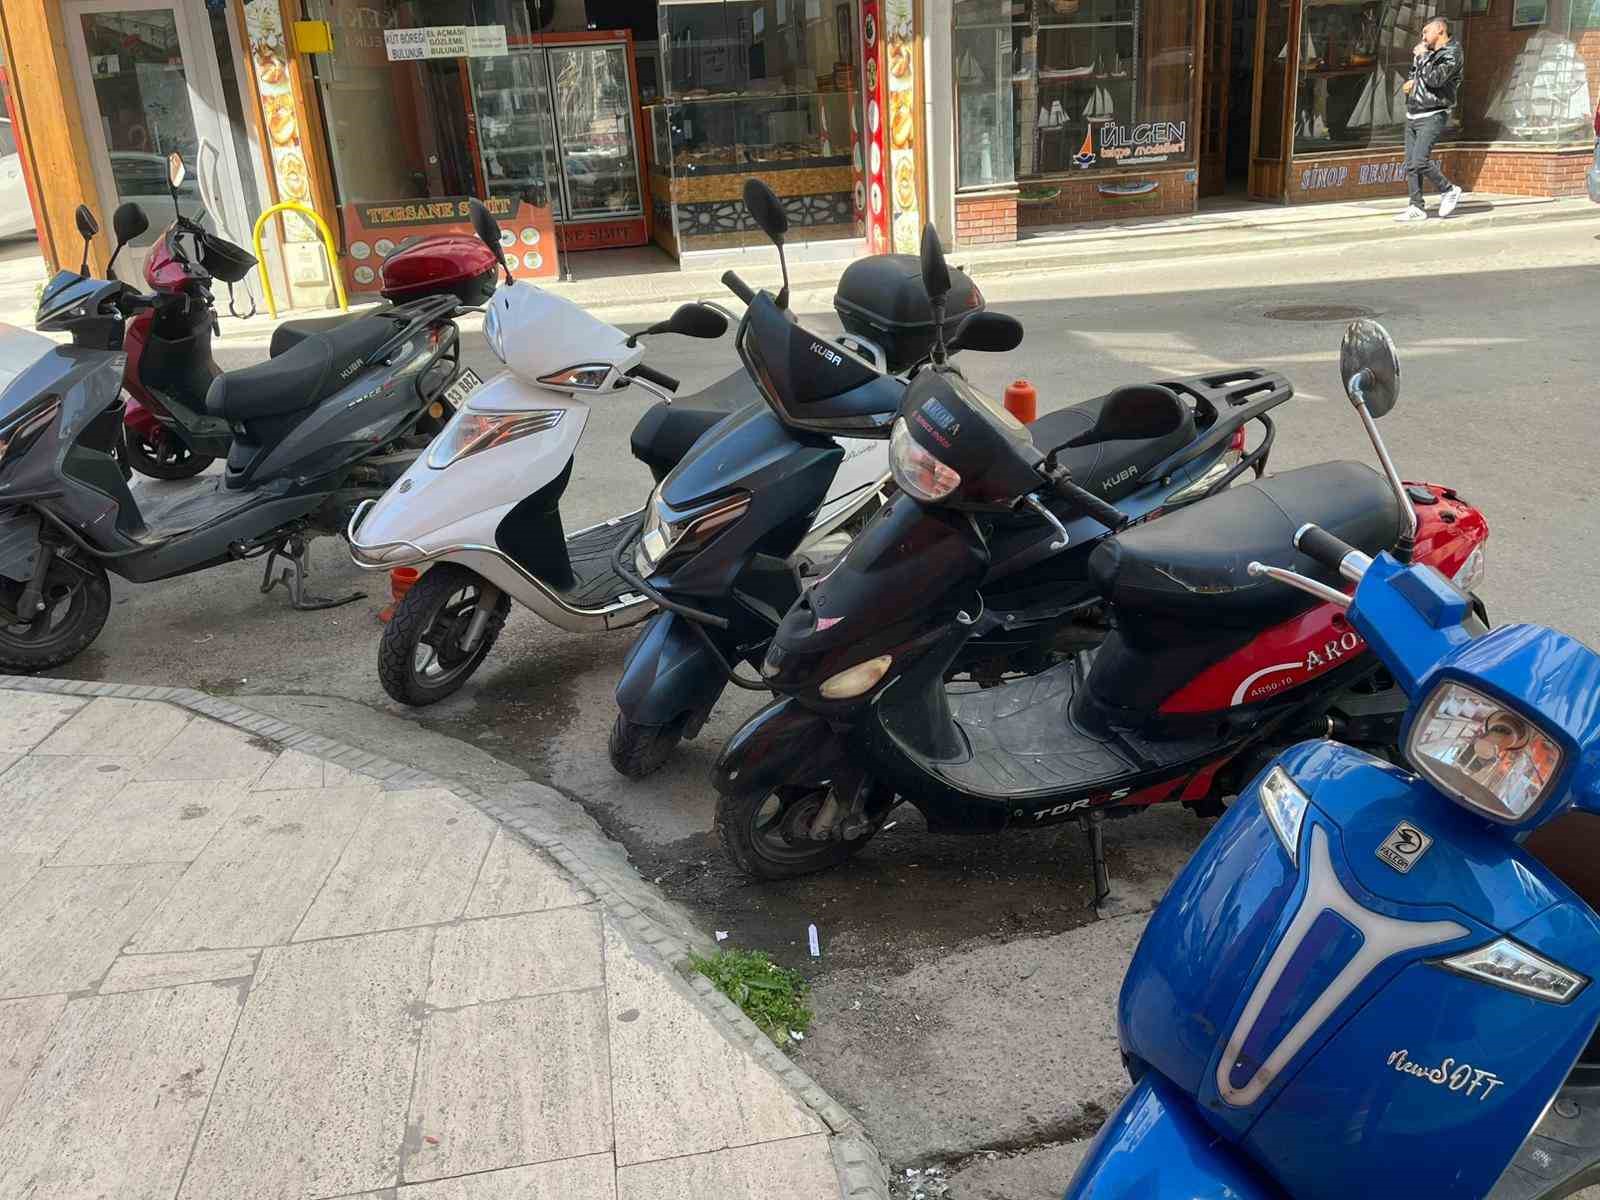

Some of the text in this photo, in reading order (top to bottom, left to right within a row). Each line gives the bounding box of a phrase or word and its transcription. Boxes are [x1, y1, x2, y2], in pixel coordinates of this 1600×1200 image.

[430, 46, 464, 56] BULUNUR
[1100, 121, 1186, 147] ÜLGEN
[366, 201, 455, 224] TERSANE
[809, 342, 842, 367] KUBA
[340, 358, 364, 379] KUBA
[1102, 464, 1138, 490] KUBA
[1306, 631, 1364, 672] ARO
